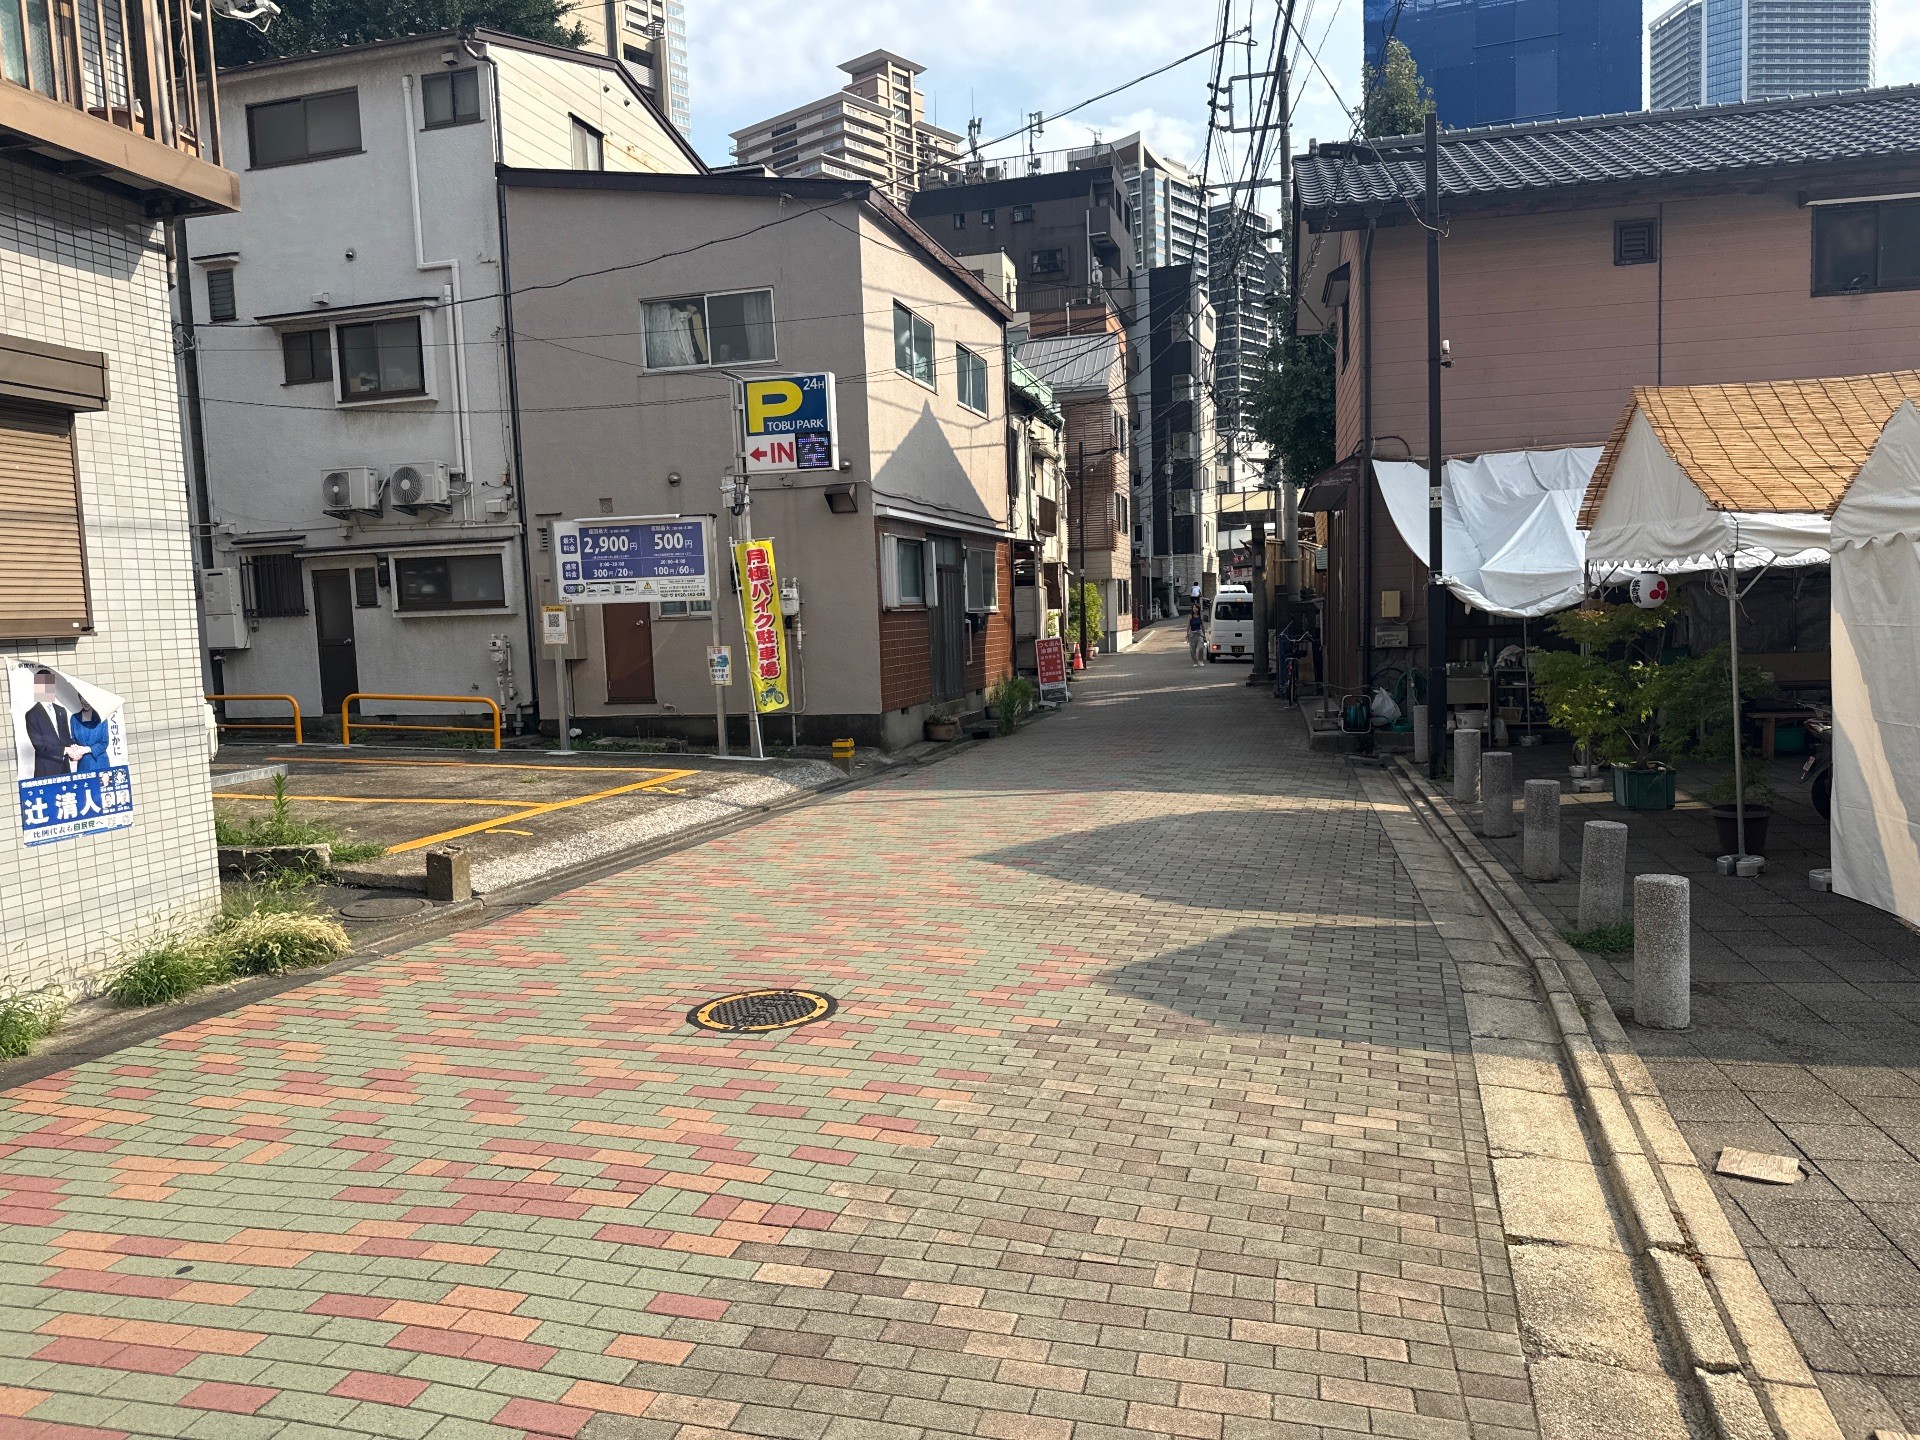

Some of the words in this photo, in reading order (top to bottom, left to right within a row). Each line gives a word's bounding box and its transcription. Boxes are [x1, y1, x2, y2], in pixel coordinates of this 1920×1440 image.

[803, 378, 824, 390] 24H
[747, 381, 803, 433] P
[767, 421, 795, 431] TOBU
[797, 419, 824, 429] PARK
[770, 441, 794, 463] IN
[583, 535, 638, 554] 2,900円
[654, 533, 693, 550] 500円
[746, 549, 781, 679] 月極バイク駐車場
[24, 797, 50, 825] 辻
[55, 789, 102, 819] 清人
[33, 820, 103, 838] 比例代表も自民党へ
